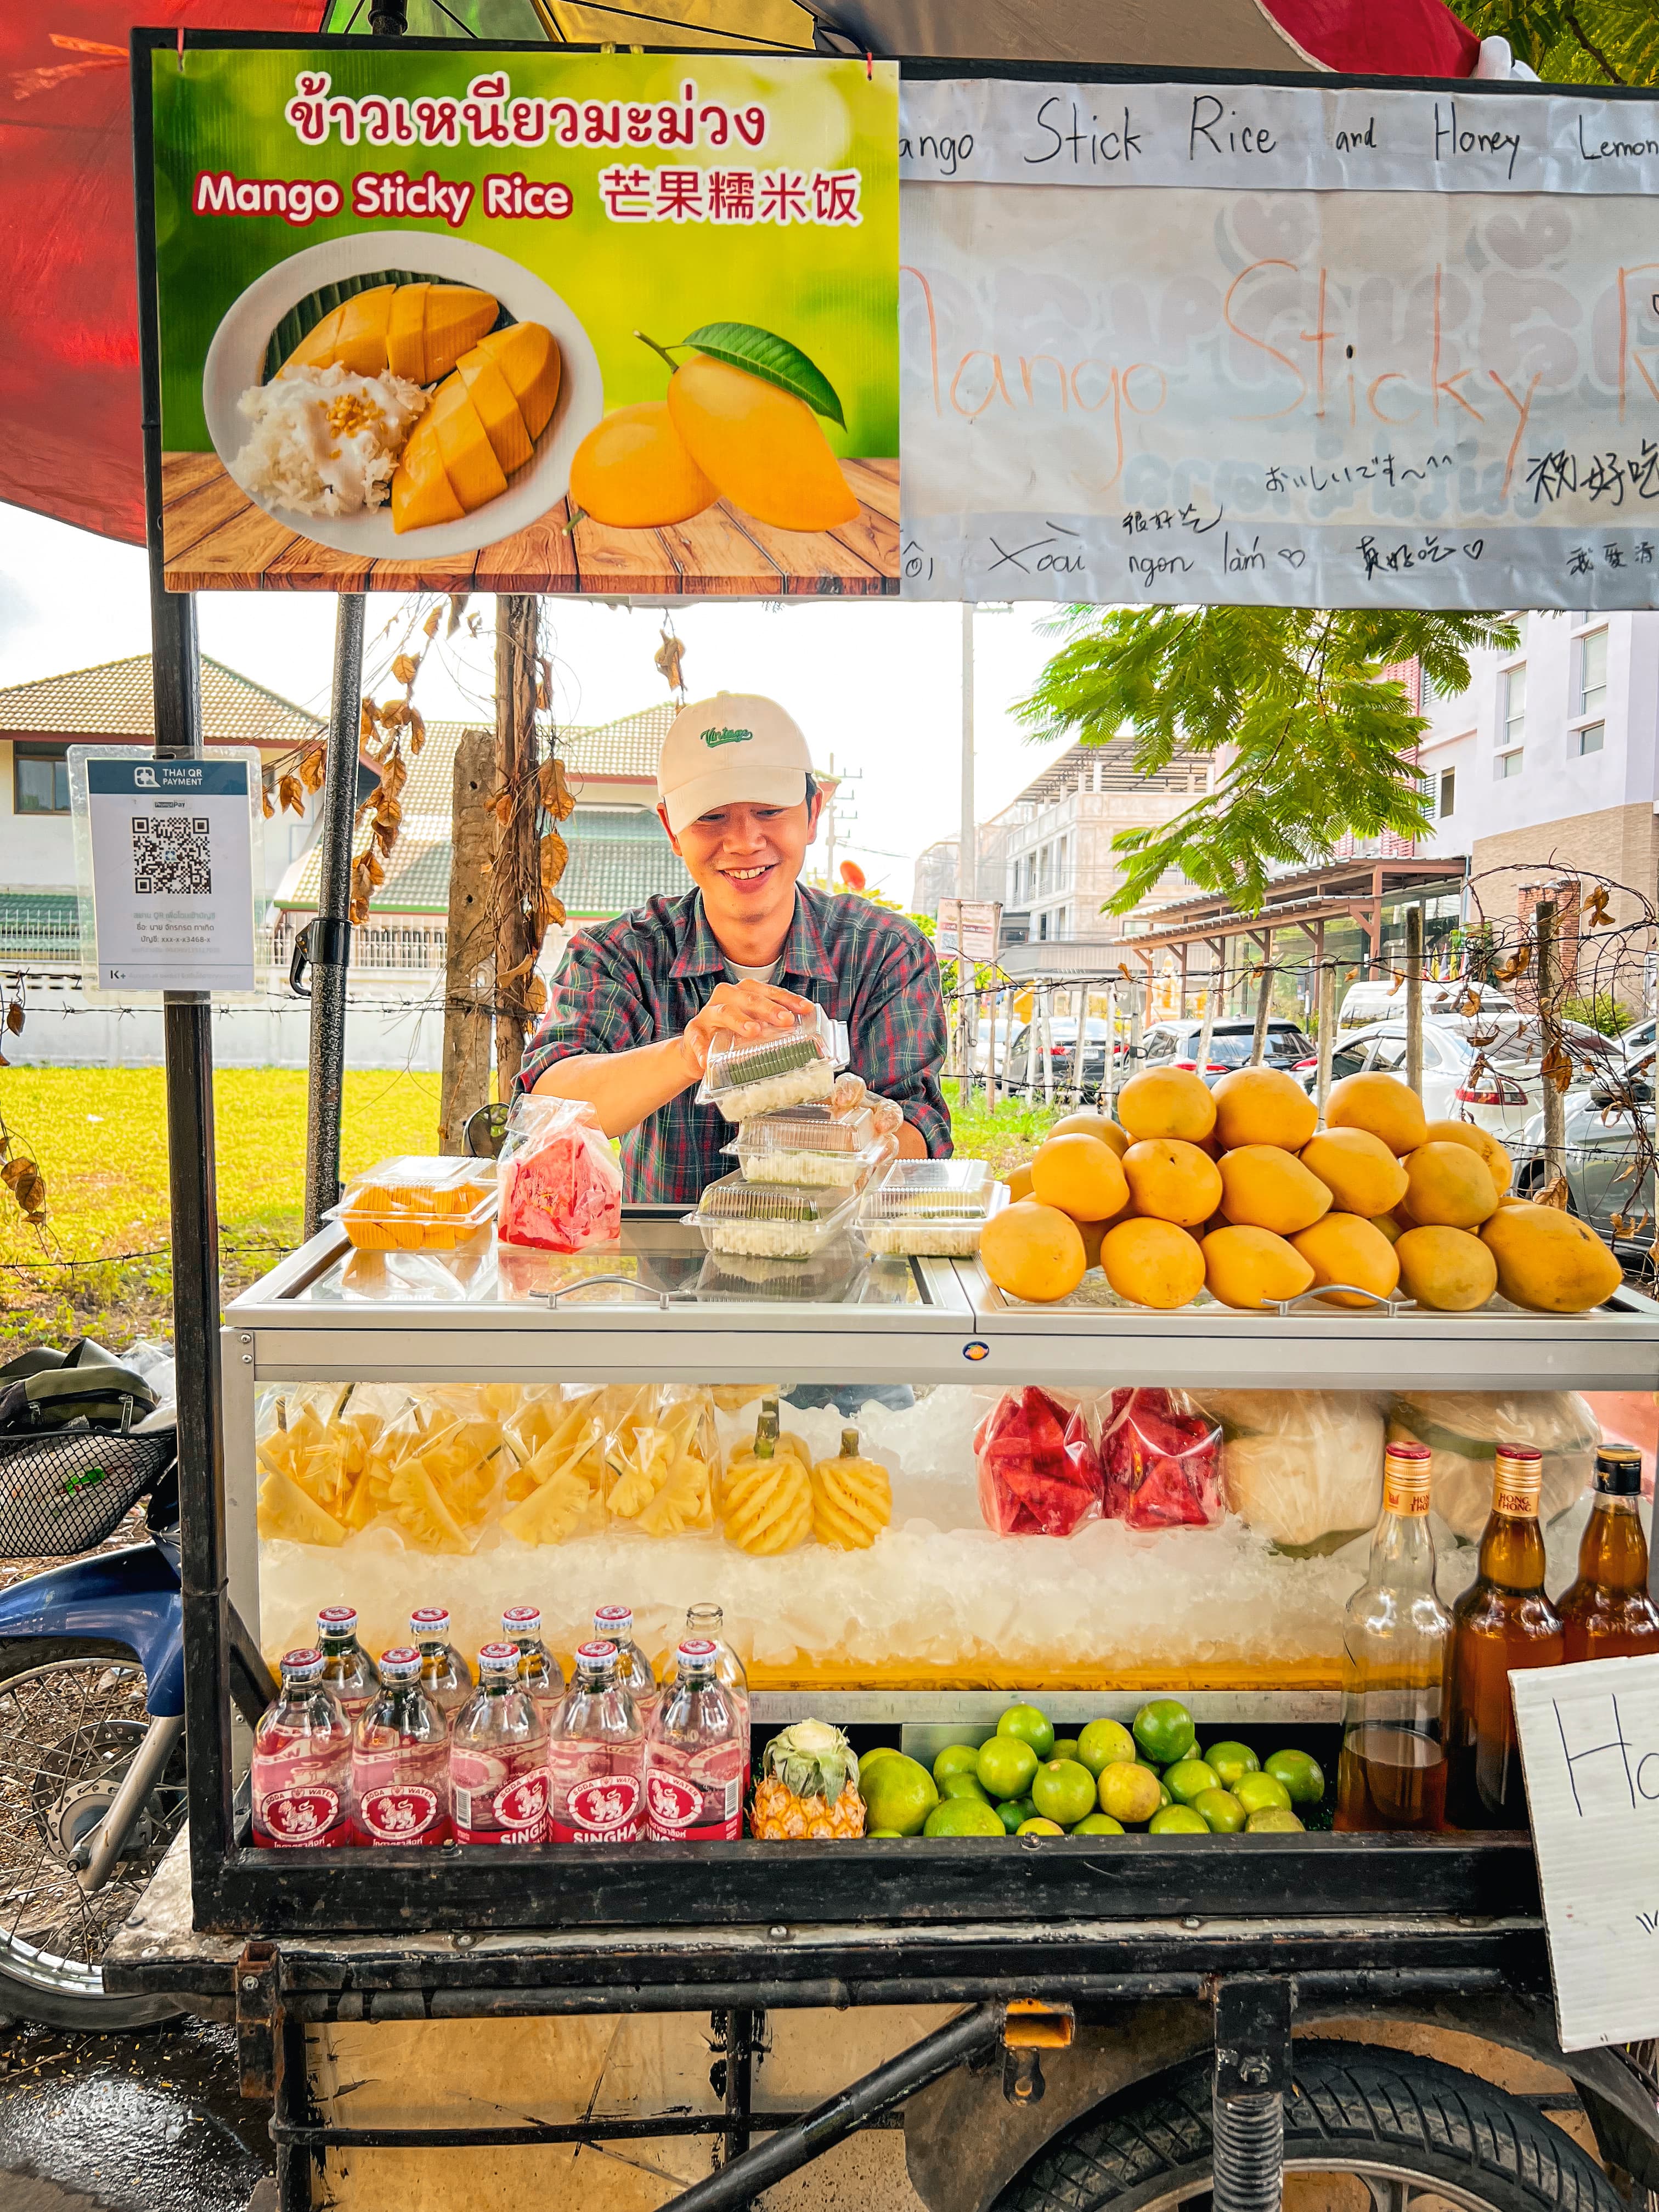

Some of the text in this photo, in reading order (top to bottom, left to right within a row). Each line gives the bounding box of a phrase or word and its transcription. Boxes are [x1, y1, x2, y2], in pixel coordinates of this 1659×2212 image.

[287, 72, 768, 147] ข้าวเหนียวมะม่วง
[1024, 97, 1142, 164] Stick
[1190, 95, 1277, 161] Rice
[1336, 116, 1376, 153] and
[1435, 101, 1520, 180] Honey
[194, 172, 572, 226] Mango Sticky Rice
[603, 170, 860, 222] 芒果糯米饭
[1224, 259, 1543, 500] Sticky
[1128, 555, 1194, 588] ngon
[162, 769, 202, 777] THAI QR
[110, 970, 126, 979] K+
[1498, 1499, 1532, 1512] THONG
[1499, 1492, 1530, 1505] HONG
[366, 1787, 434, 1802] SODA WATER
[499, 1781, 522, 1798] SODA
[573, 1776, 637, 1796] SODA WATER
[673, 1778, 698, 1797] WATER
[266, 1788, 335, 1805] SODA WATER
